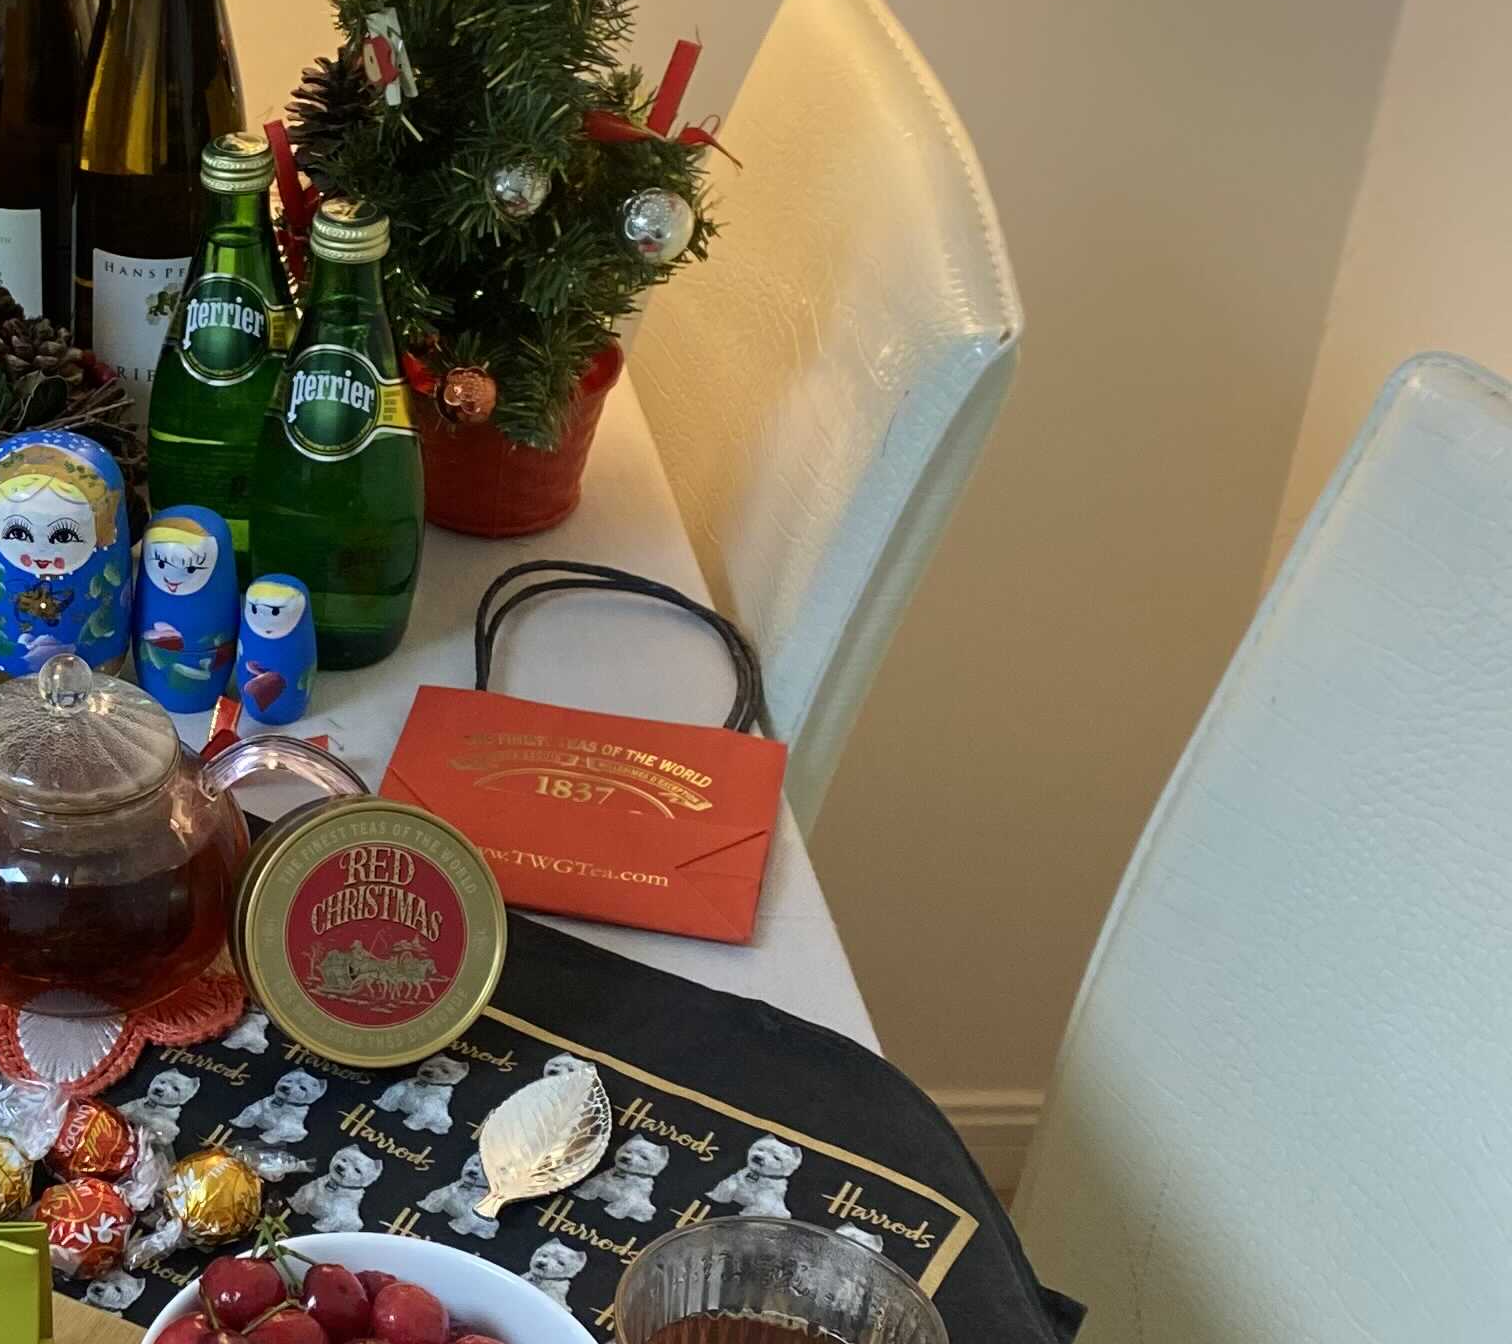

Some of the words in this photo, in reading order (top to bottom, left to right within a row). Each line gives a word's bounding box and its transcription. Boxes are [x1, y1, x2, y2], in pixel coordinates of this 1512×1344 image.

[104, 260, 156, 280] HANS
[601, 743, 623, 758] OF
[626, 748, 659, 768] THE
[658, 758, 713, 789] WORLD
[535, 775, 616, 806] 1837
[350, 820, 388, 838] TEAS
[392, 821, 411, 838] OF
[339, 845, 417, 887] RED
[311, 884, 444, 943] CHRISTMAS
[158, 1046, 252, 1087] Harrods
[449, 1039, 520, 1072] arrods
[337, 1103, 437, 1173] Harrods
[615, 1096, 720, 1164] Harrods
[536, 1196, 646, 1266] Harrods
[822, 1180, 938, 1251] Harrods
